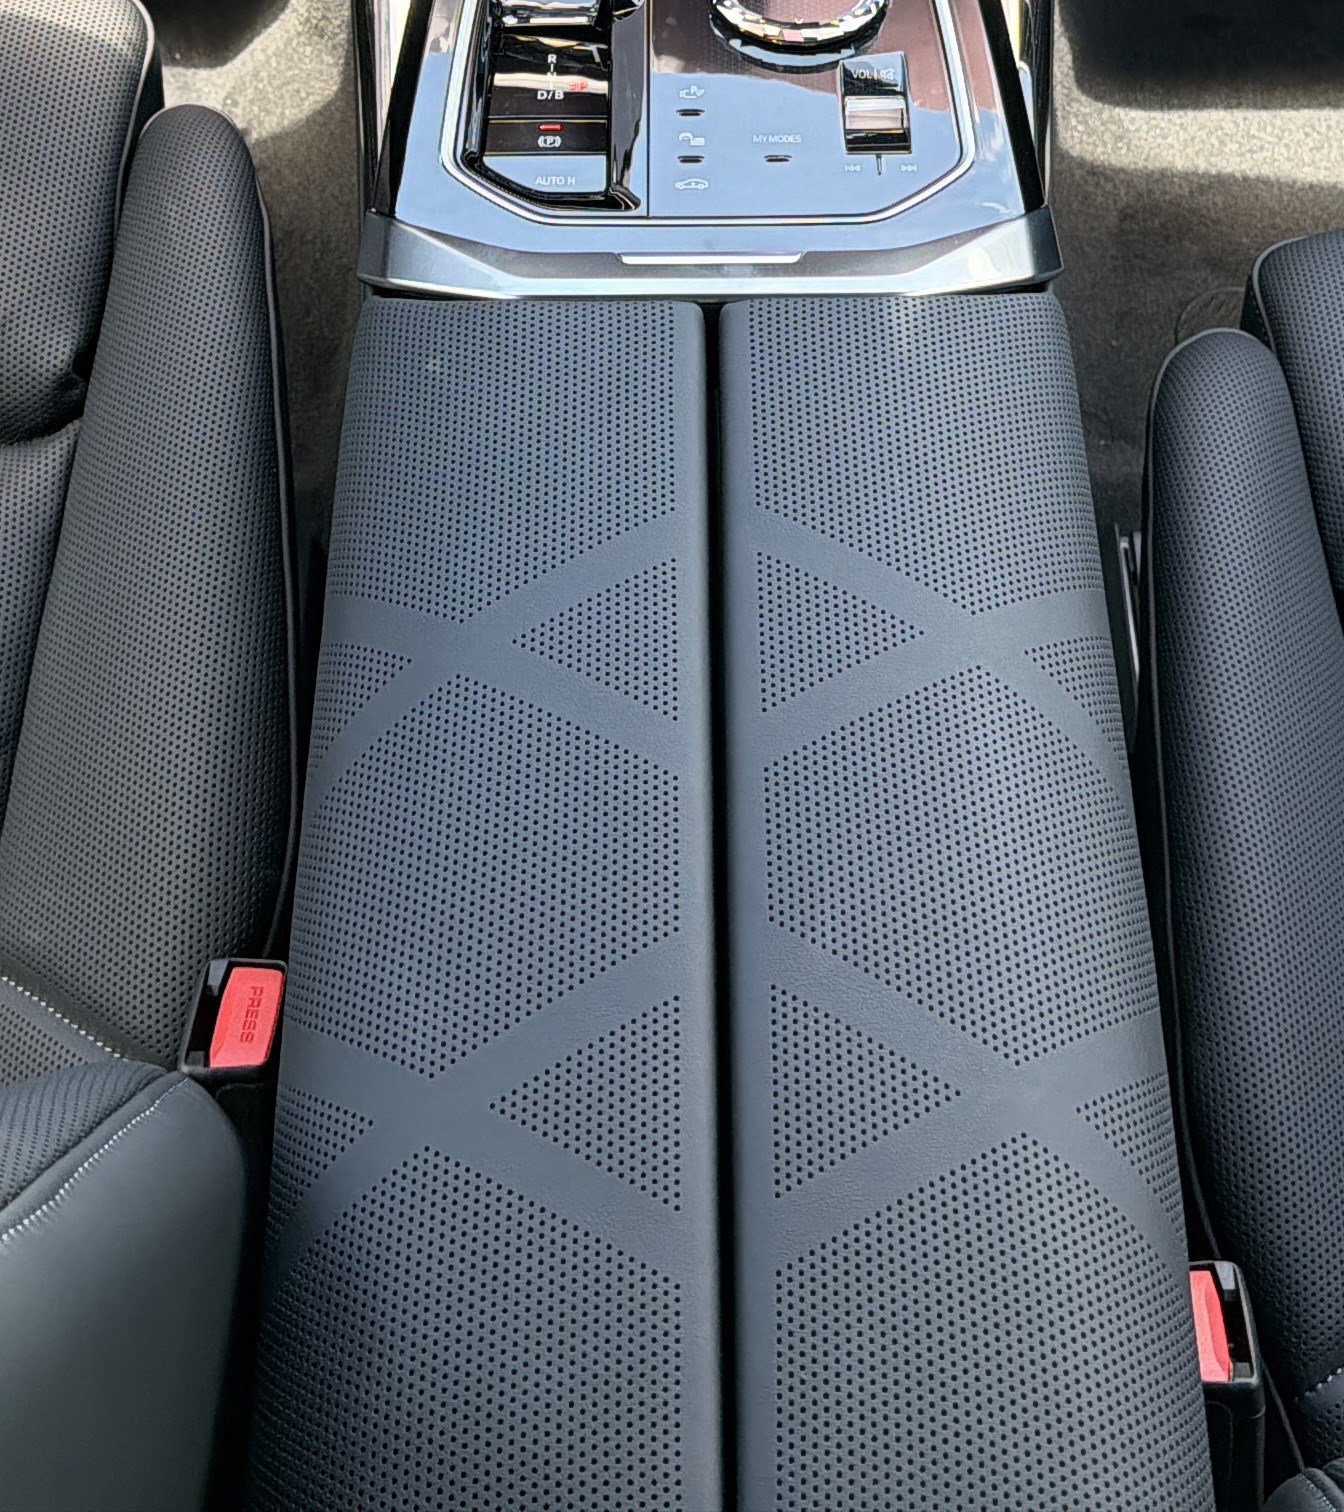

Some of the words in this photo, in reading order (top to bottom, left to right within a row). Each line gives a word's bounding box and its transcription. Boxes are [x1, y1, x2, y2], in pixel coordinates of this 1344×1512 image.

[547, 54, 557, 64] R
[753, 134, 768, 144] MY
[768, 134, 802, 144] MODES
[536, 176, 565, 186] AUTO
[567, 176, 576, 186] H
[239, 985, 265, 1044] PRESS
